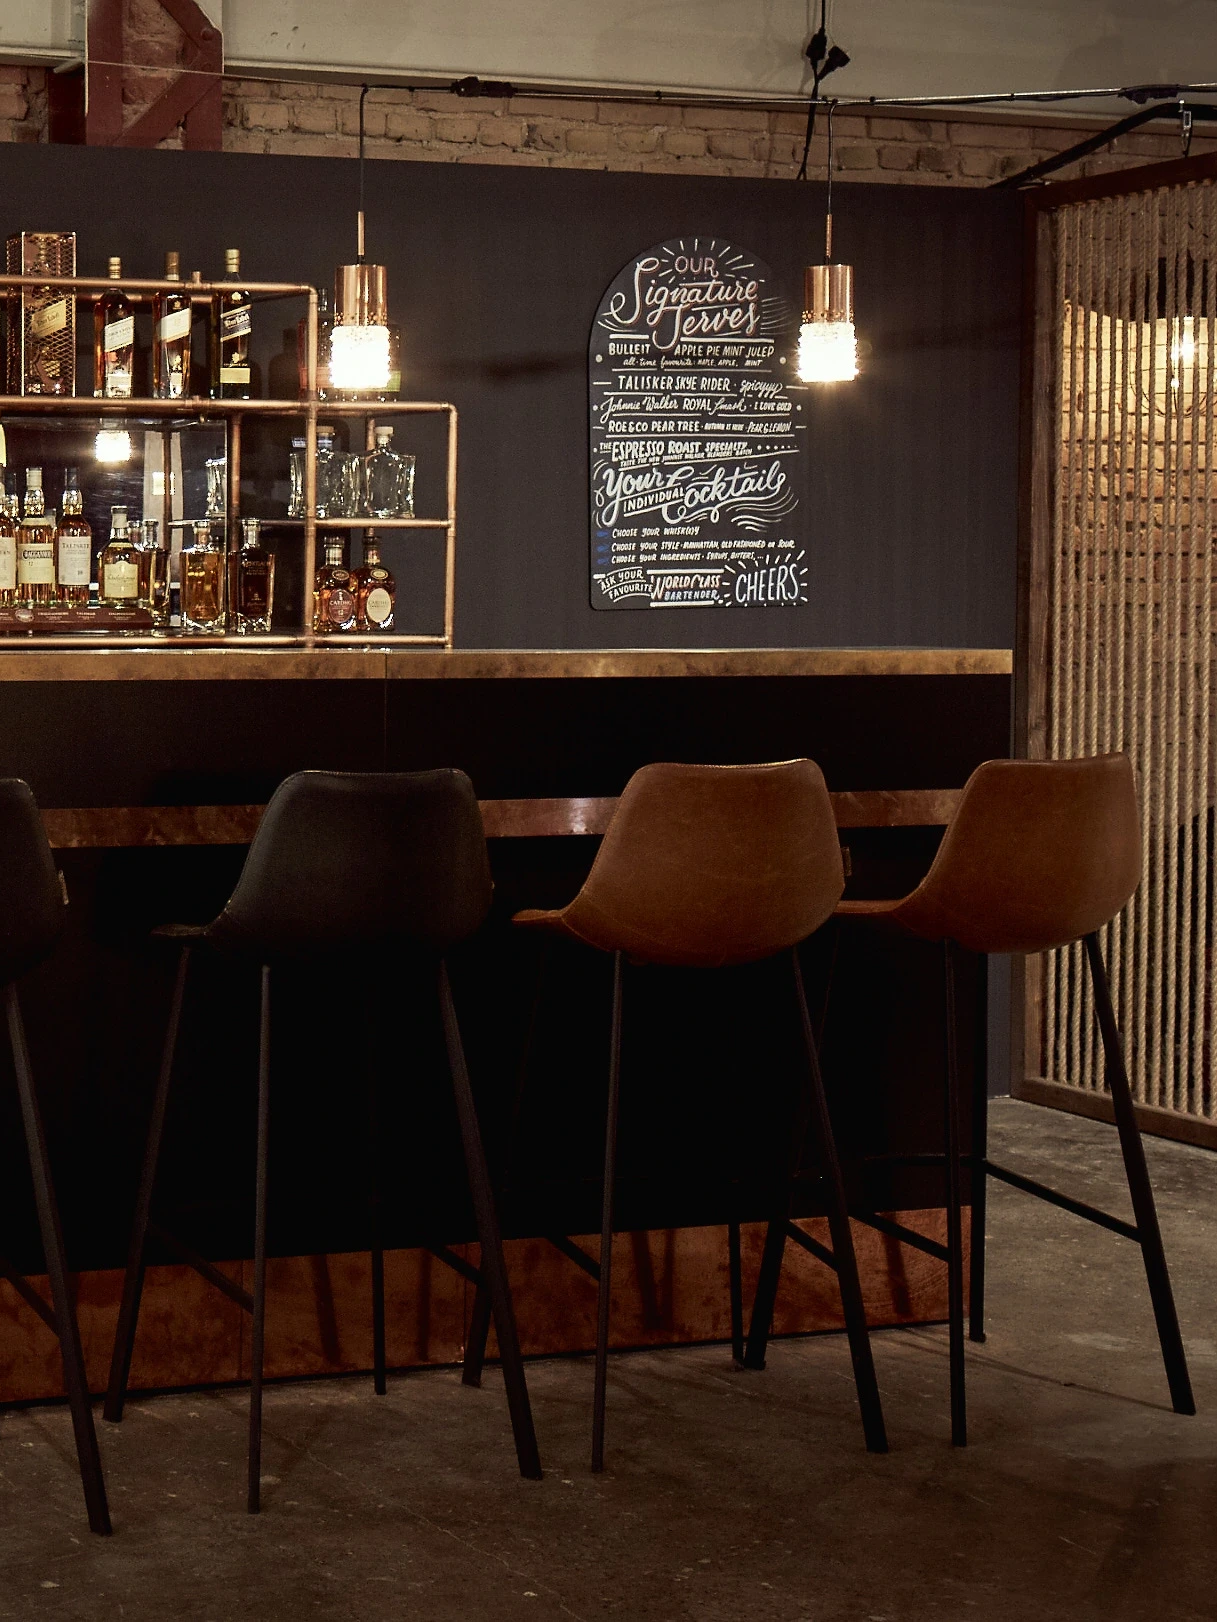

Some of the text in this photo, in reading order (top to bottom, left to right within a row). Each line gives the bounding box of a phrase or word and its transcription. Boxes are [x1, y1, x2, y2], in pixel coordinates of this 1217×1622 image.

[675, 256, 718, 278] OUR
[601, 258, 758, 324] Signature
[609, 343, 775, 358] BULLEIT APPLE PIE MINT JULEP
[744, 359, 763, 367] MINT
[618, 375, 673, 390] TALISKER
[674, 376, 698, 390] SKYE
[700, 377, 731, 391] RIDER
[600, 396, 641, 424] Johnnie
[642, 394, 679, 411] Walker
[682, 399, 712, 411] ROYAL
[759, 401, 775, 411] LOVE
[776, 402, 792, 412] GOLD
[651, 421, 675, 433] PEAR
[677, 421, 700, 432] TREE
[599, 440, 748, 462] THE ESPRESSO ROAST SPECIALTY
[602, 460, 786, 526] Your Cocktail
[623, 487, 685, 512] INDIVIDUAL
[612, 528, 638, 538] CHOOSE
[641, 527, 660, 537] YOUR
[611, 542, 636, 552] CHOOSE
[639, 542, 658, 551] YOUR
[661, 541, 680, 550] STYLE
[721, 540, 733, 549] OLD
[611, 554, 636, 564] CHOOSE
[639, 554, 657, 562] YOUR
[660, 553, 701, 561] INGREDIENTS
[600, 569, 645, 591] ASK YOUR
[650, 574, 720, 600] WORLD CLASS
[736, 563, 799, 603] CHEERS
[609, 583, 653, 600] FAVOURITE
[664, 589, 720, 601] BARTENDER
